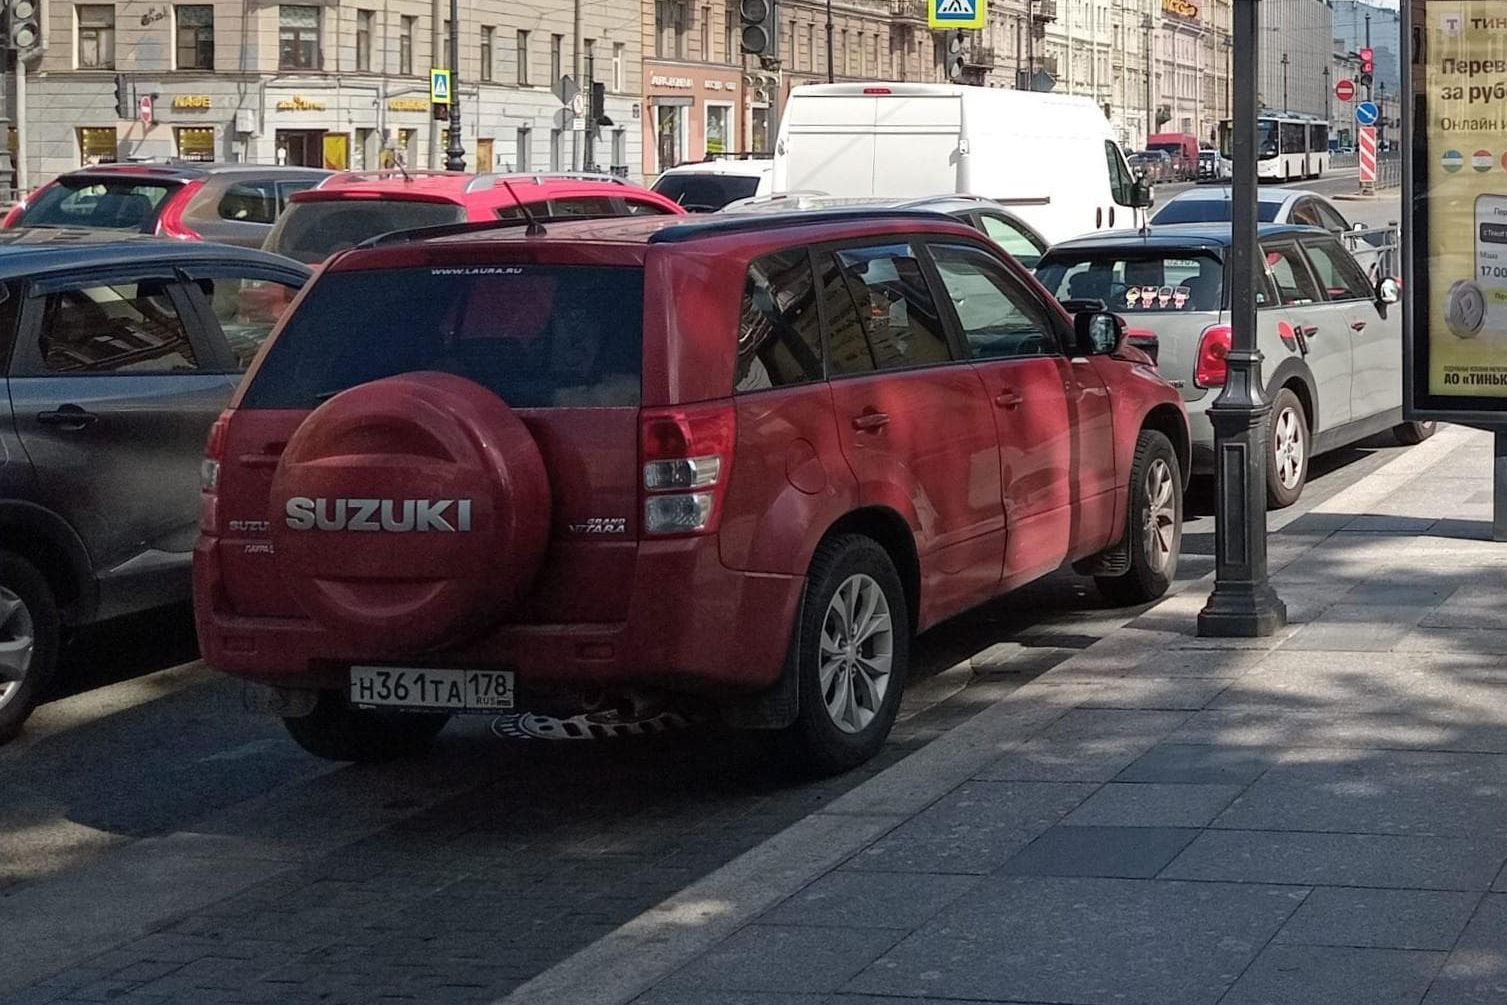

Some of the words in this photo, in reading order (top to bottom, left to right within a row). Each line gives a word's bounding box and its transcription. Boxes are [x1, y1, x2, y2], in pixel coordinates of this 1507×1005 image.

[1441, 86, 1463, 100] за
[1441, 116, 1497, 130] Онлайн
[1481, 265, 1492, 276] 17
[1444, 373, 1460, 385] АО
[285, 498, 472, 533] SUZUKI
[586, 517, 626, 525] GRAND
[229, 520, 270, 531] SUZU
[359, 671, 462, 703] Н361ТА
[468, 673, 507, 696] 178
[476, 698, 496, 706] RUS
